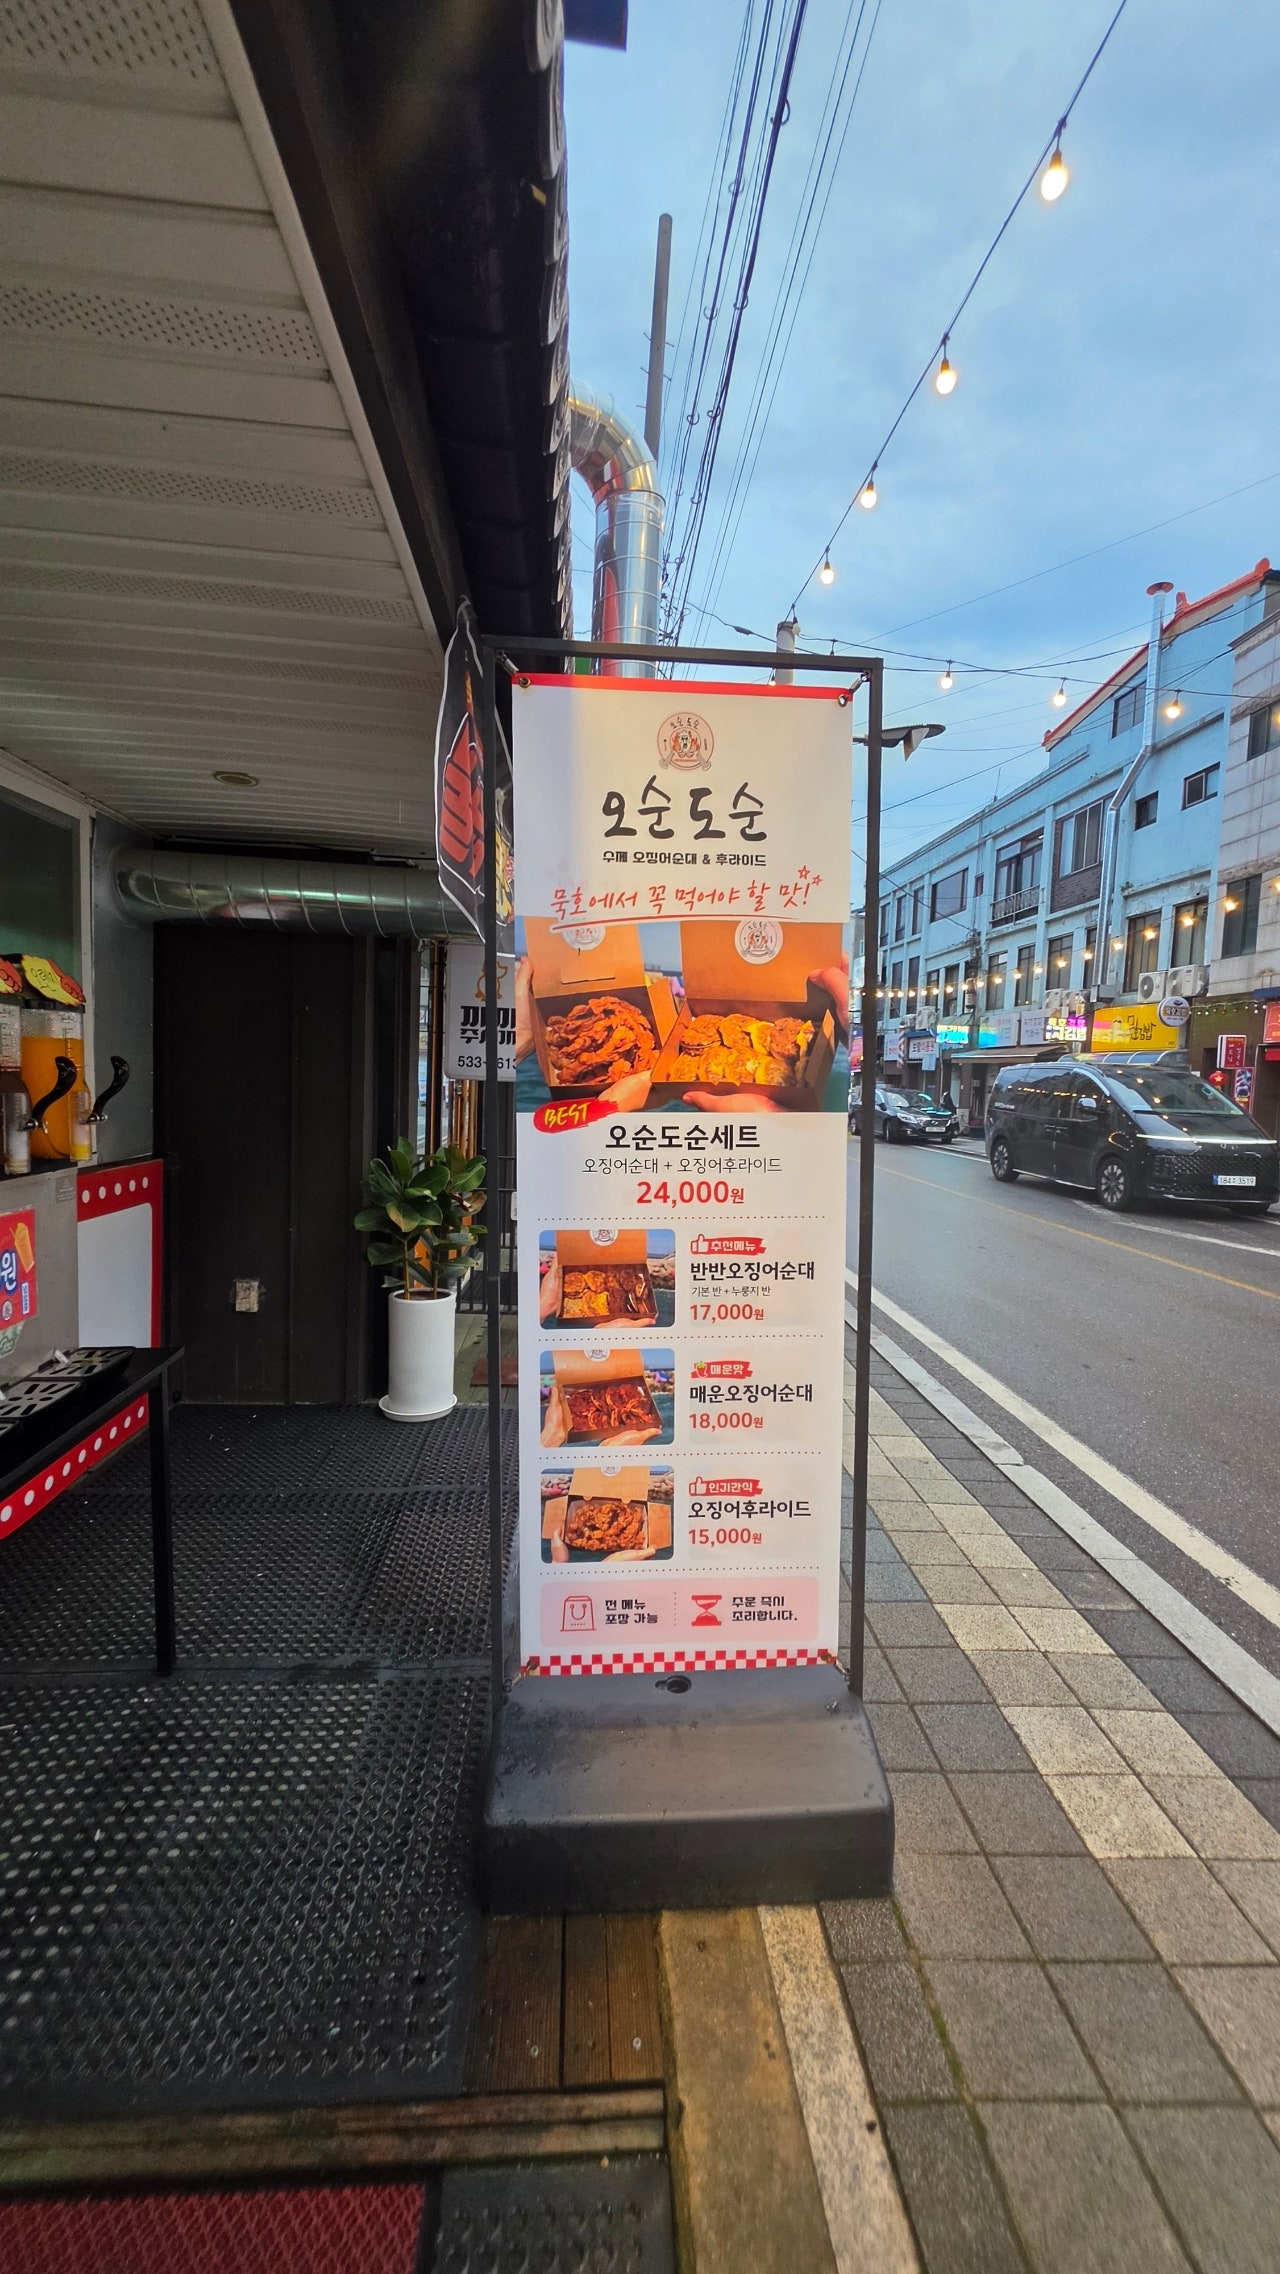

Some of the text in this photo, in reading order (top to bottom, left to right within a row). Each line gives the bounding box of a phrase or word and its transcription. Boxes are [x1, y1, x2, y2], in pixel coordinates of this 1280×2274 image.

[602, 775, 767, 841] 오순도순
[603, 851, 767, 867] 수제 오징어순대 & 후라이드
[550, 879, 811, 919] 묵호에서 꼭 먹어야 할 맛!
[543, 1102, 589, 1129] BEST
[606, 1125, 761, 1151] 오순도순세트
[582, 1157, 783, 1174] 오징어순대 + 오징어후라이드
[636, 1180, 745, 1208] 24,000원
[711, 1240, 756, 1252] 추천메뉴
[690, 1261, 815, 1281] 반반오징어순대
[691, 1286, 711, 1298] 기본
[712, 1286, 723, 1297] 반
[731, 1286, 760, 1298] 누룽지
[761, 1285, 772, 1297] 반
[689, 1303, 764, 1323] 17,000원
[710, 1364, 744, 1376] 매운맛
[690, 1383, 813, 1404] 매운오징어순대
[689, 1412, 764, 1432] 18,000원
[709, 1482, 753, 1494] 인기간식
[688, 1499, 812, 1519] 오징어후라이드
[688, 1527, 762, 1547] 15,000원
[605, 1599, 646, 1611] 전 메뉴
[732, 1596, 785, 1608] 주문 즉시
[605, 1613, 659, 1625] 포장 가능
[732, 1610, 798, 1622] 조리합니다.
